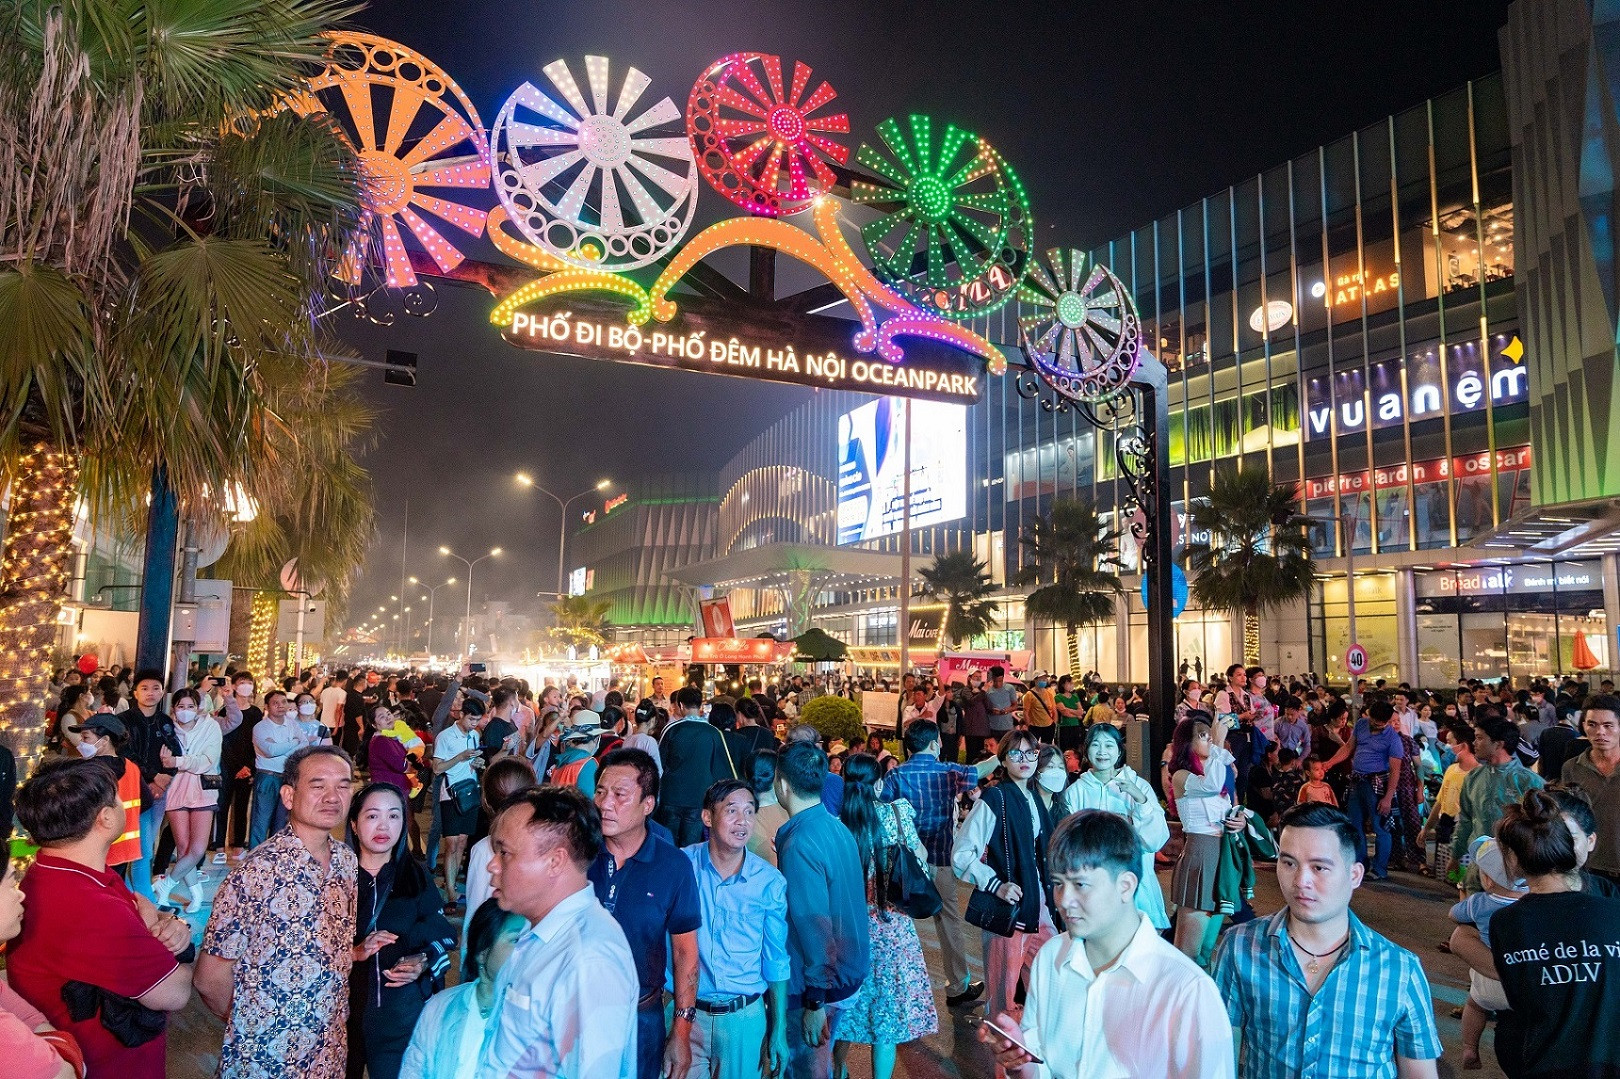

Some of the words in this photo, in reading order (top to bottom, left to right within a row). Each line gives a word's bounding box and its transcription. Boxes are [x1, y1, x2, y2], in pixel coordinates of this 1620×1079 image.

[1335, 272, 1400, 305] ATAS
[511, 309, 572, 341] PHỐ
[576, 324, 603, 346] ĐI
[608, 325, 704, 360] BỘ-PHỐ
[710, 340, 760, 368] ĐÊM
[767, 346, 799, 373] HÀ
[806, 353, 846, 383] NỘI
[852, 361, 978, 395] OCEANPARK
[1313, 474, 1362, 497] pierre
[1367, 464, 1426, 485] ardn
[1465, 450, 1526, 472] oscar
[908, 619, 926, 638] Mai
[1350, 653, 1363, 667] 40
[1503, 943, 1550, 965] acmé
[1554, 942, 1578, 959] de
[1580, 940, 1602, 958] la
[1540, 962, 1602, 986] ADLV
